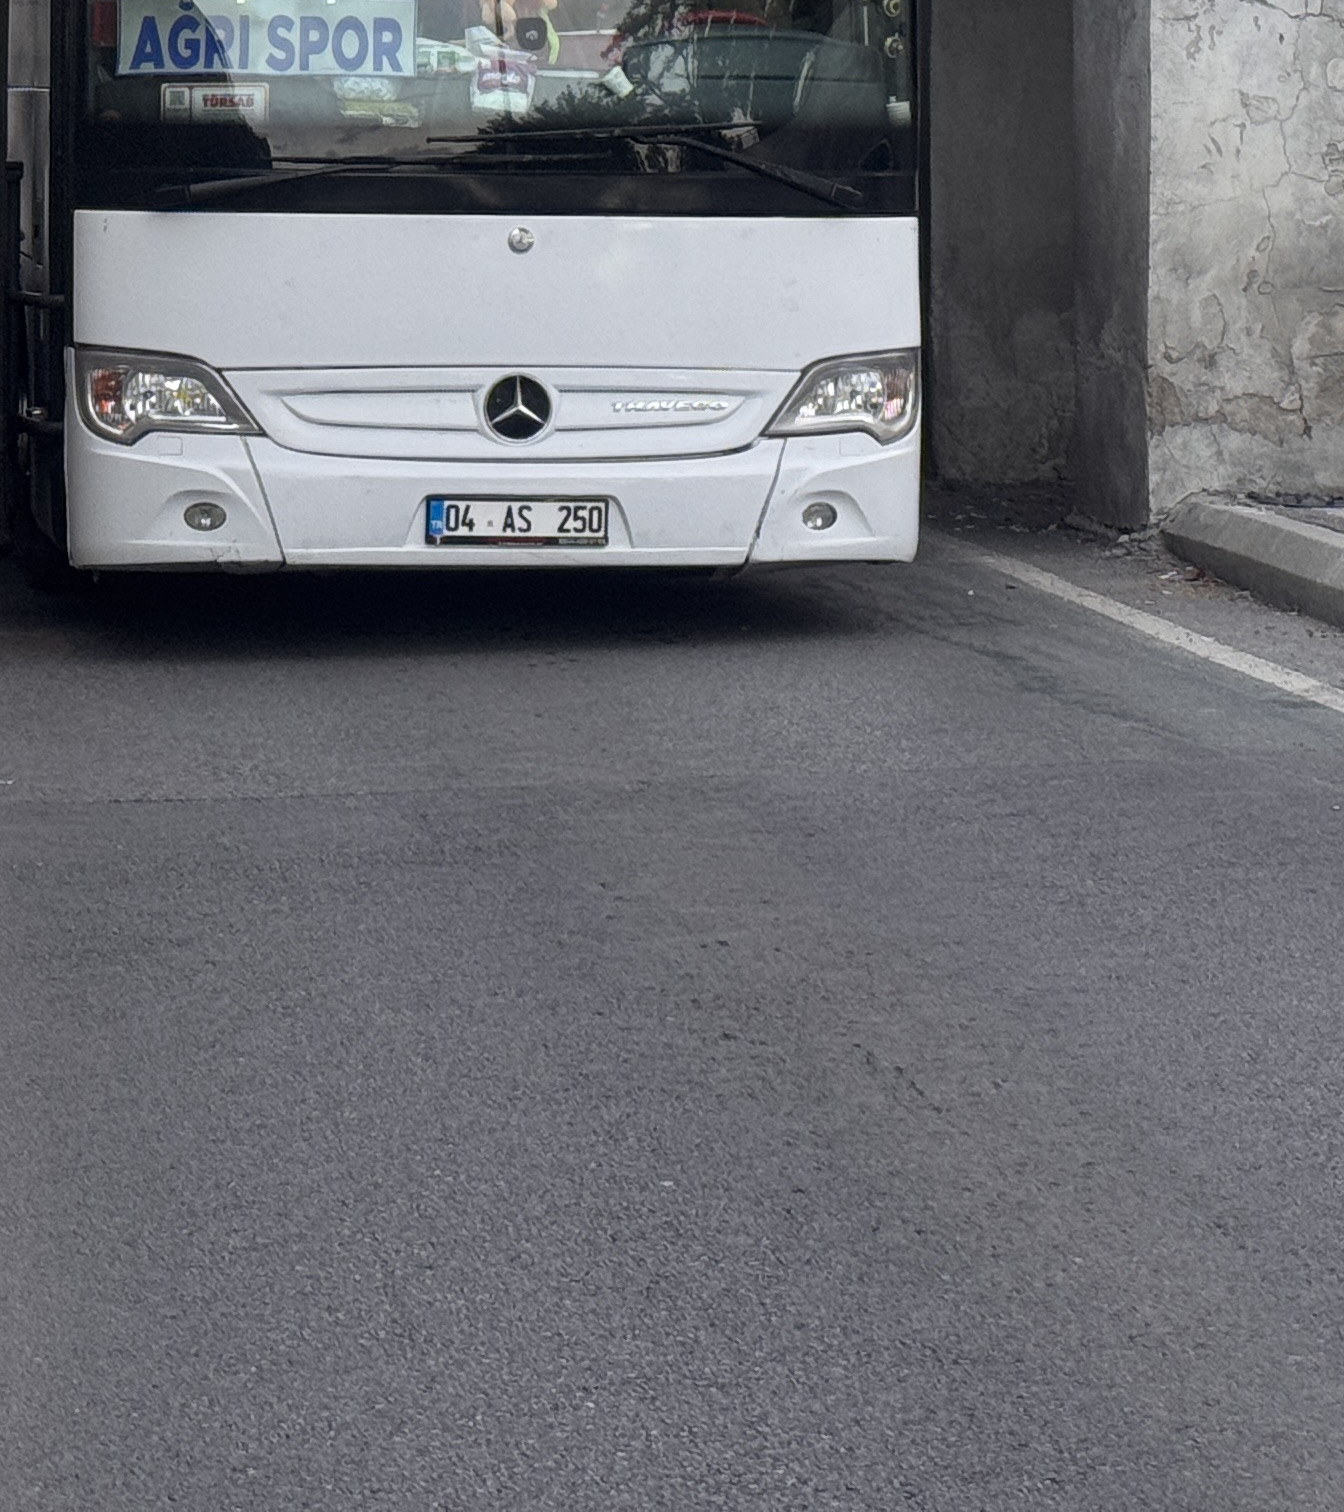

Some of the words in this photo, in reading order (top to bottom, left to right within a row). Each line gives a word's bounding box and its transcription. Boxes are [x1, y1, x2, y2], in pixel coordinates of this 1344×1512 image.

[129, 0, 250, 71] AĞRI
[265, 14, 403, 72] SPOR
[445, 504, 475, 532] 04
[502, 504, 533, 533] AS
[557, 505, 603, 534] 250
